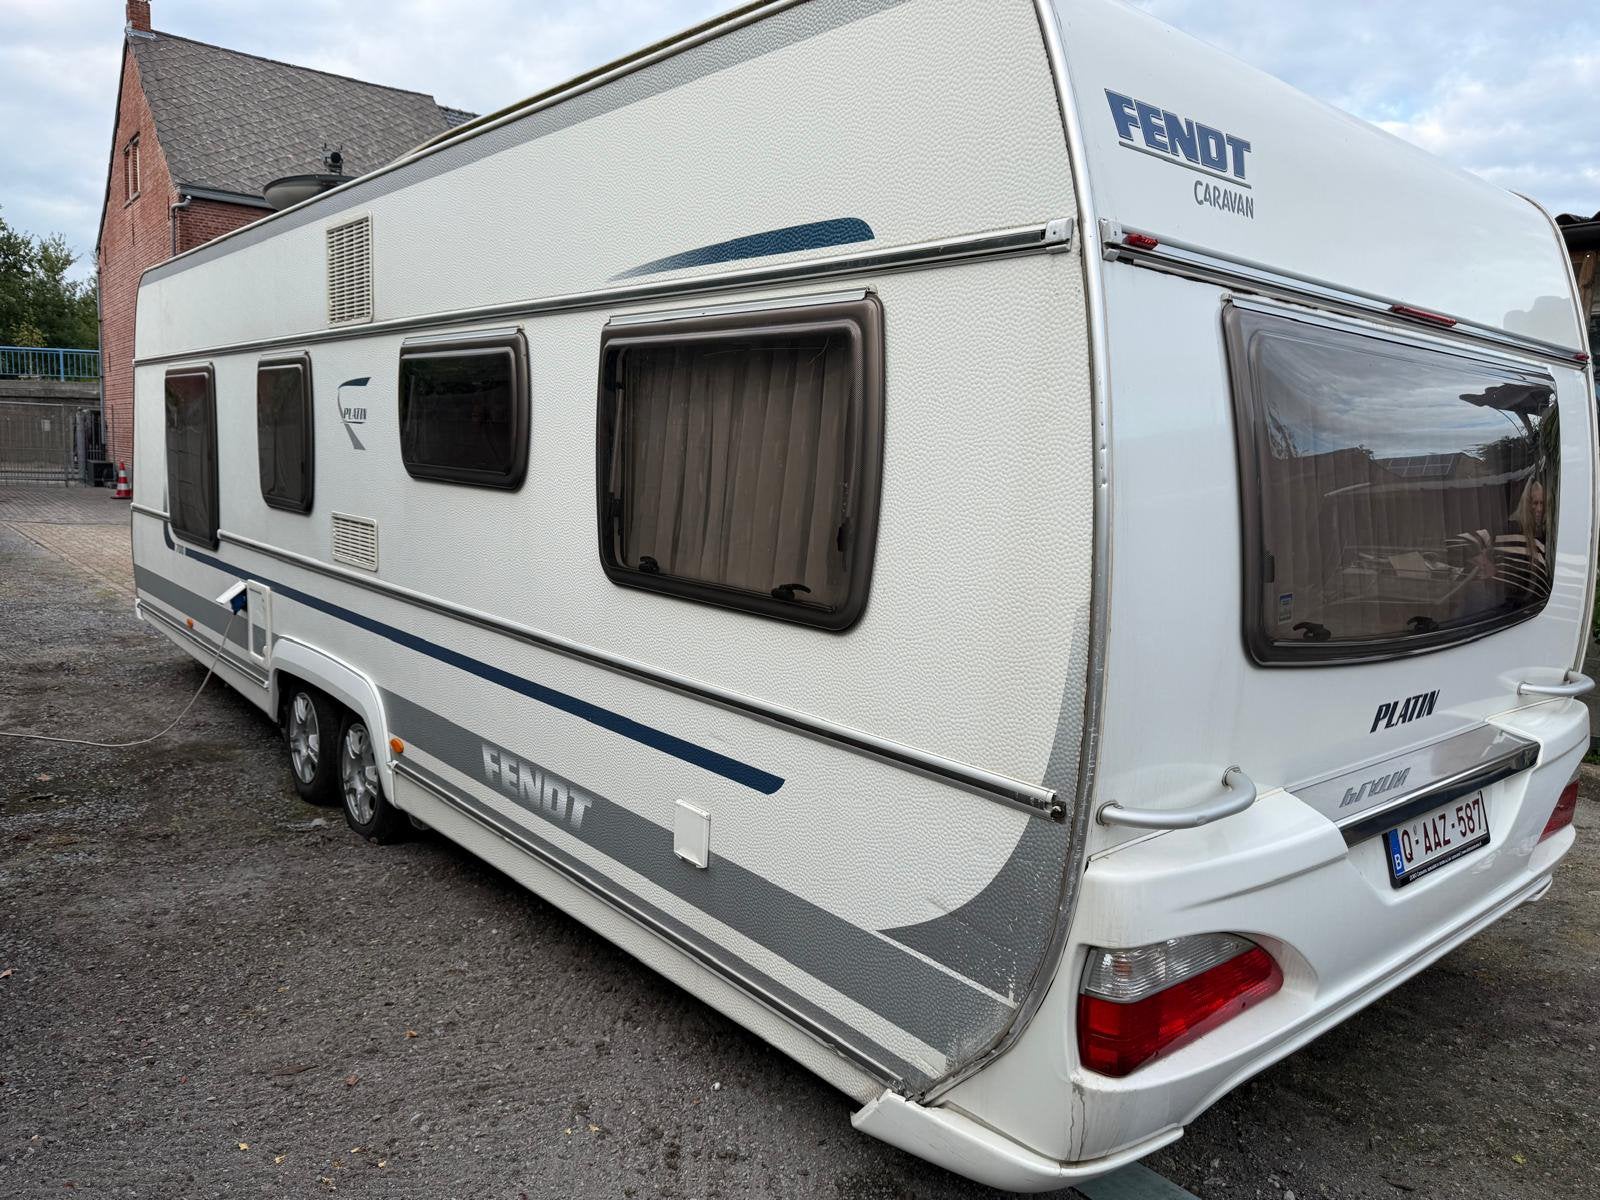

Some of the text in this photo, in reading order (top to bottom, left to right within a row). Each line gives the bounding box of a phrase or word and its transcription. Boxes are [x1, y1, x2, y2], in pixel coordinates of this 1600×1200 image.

[1104, 88, 1252, 179] FENDT
[1194, 180, 1254, 219] CARAVAN
[343, 407, 367, 420] PLATIN
[1369, 689, 1440, 734] PLATIN
[482, 743, 593, 829] FENDT
[1394, 854, 1402, 870] B
